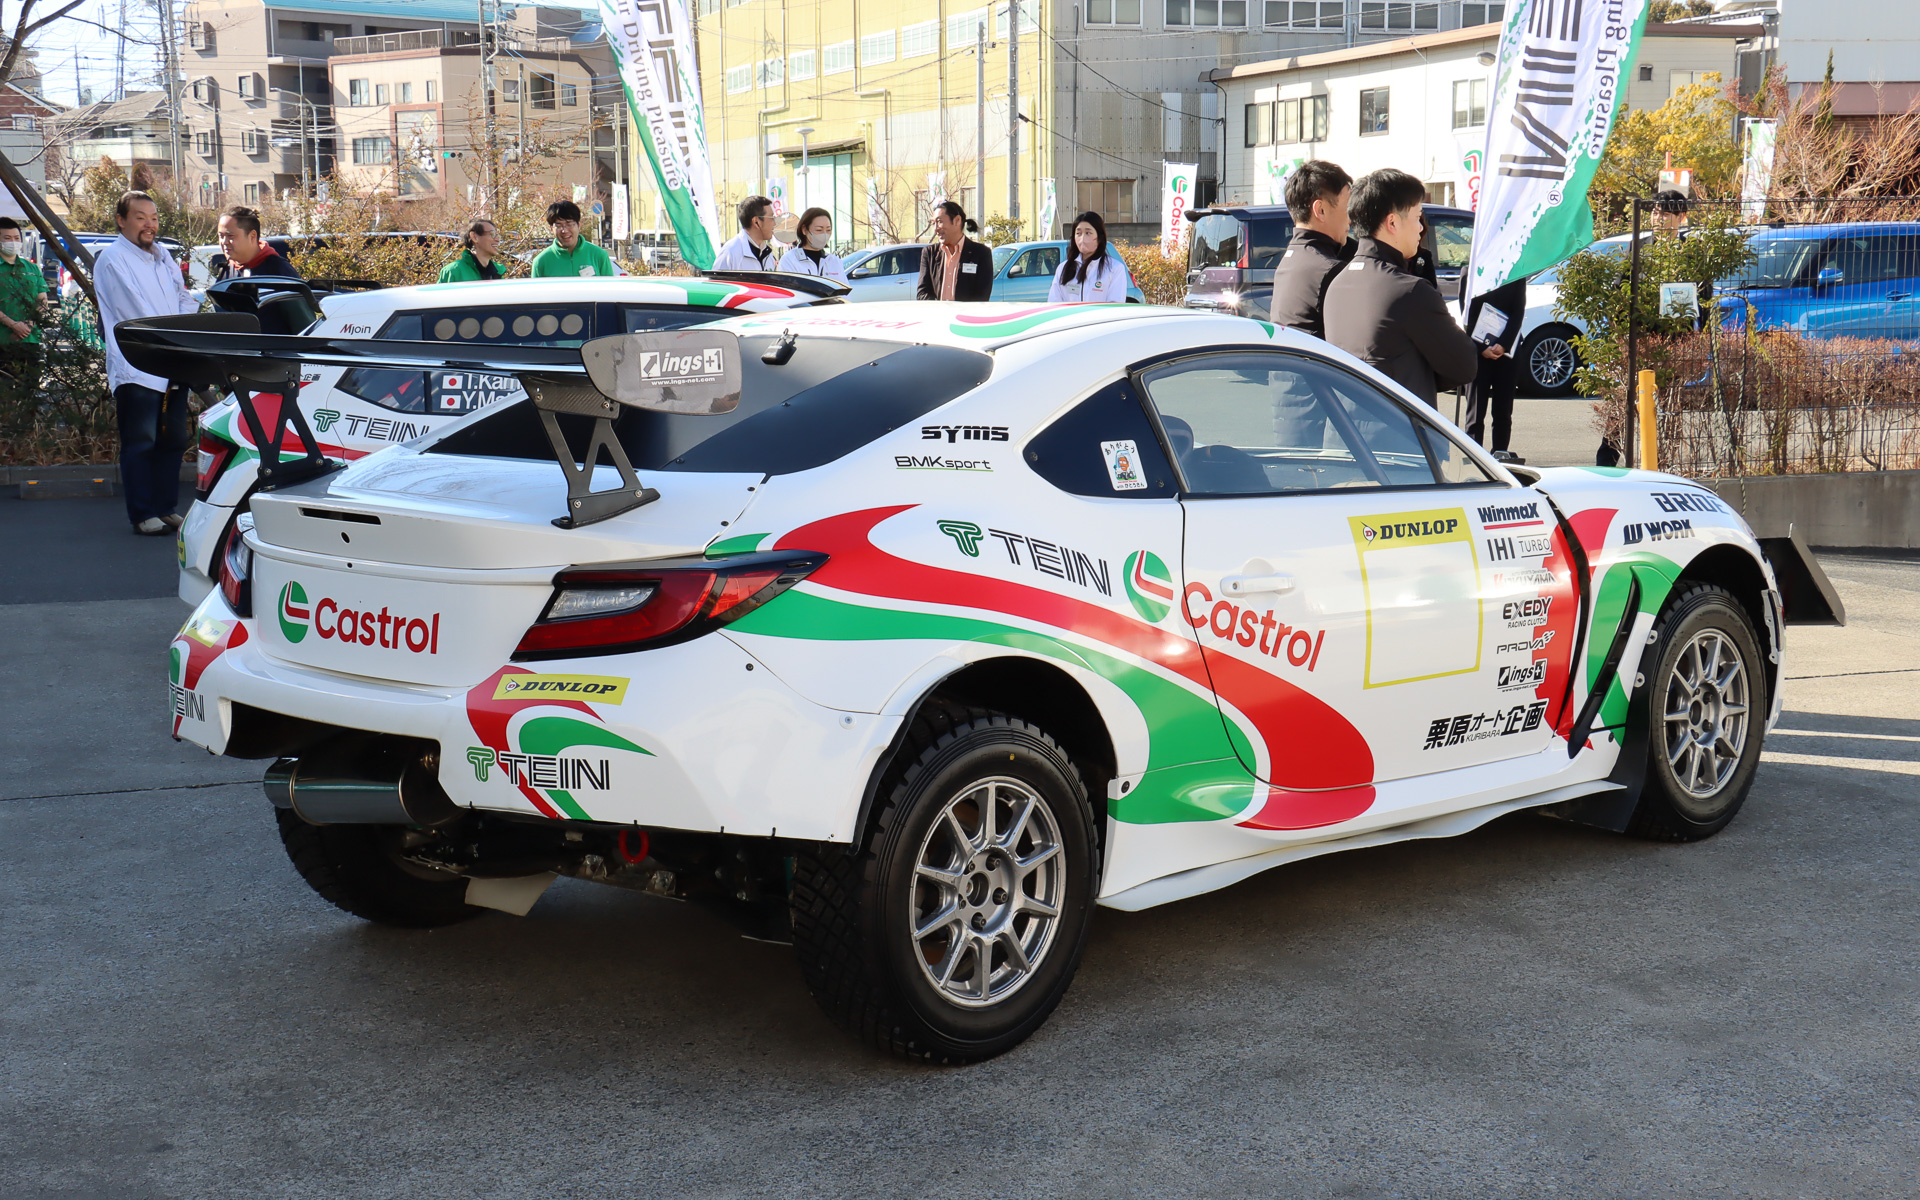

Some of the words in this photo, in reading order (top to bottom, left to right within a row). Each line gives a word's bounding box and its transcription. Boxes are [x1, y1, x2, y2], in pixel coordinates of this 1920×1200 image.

[623, 21, 653, 101] Driving
[647, 104, 679, 189] Pleasure
[1170, 196, 1185, 249] Castro
[785, 318, 922, 329] Castrol
[345, 414, 430, 443] TEIN
[1650, 493, 1730, 515] BRIDE
[1380, 519, 1458, 540] DUNLOP
[1644, 519, 1695, 542] WORK
[1487, 537, 1516, 561] IHI
[1519, 539, 1550, 552] TURBO
[988, 528, 1112, 597] TEIN
[1503, 598, 1551, 620] EXEDY
[315, 597, 440, 655] Castrol
[1181, 582, 1326, 672] Castrol
[1508, 620, 1527, 629] RACING
[1527, 617, 1547, 626] CLUTCH
[1497, 639, 1545, 654] PROVA
[521, 681, 617, 694] DUNLOP
[1423, 701, 1547, 750] 栗原オート企画
[1466, 729, 1500, 742] KURIBARA
[500, 753, 611, 790] TEIN
